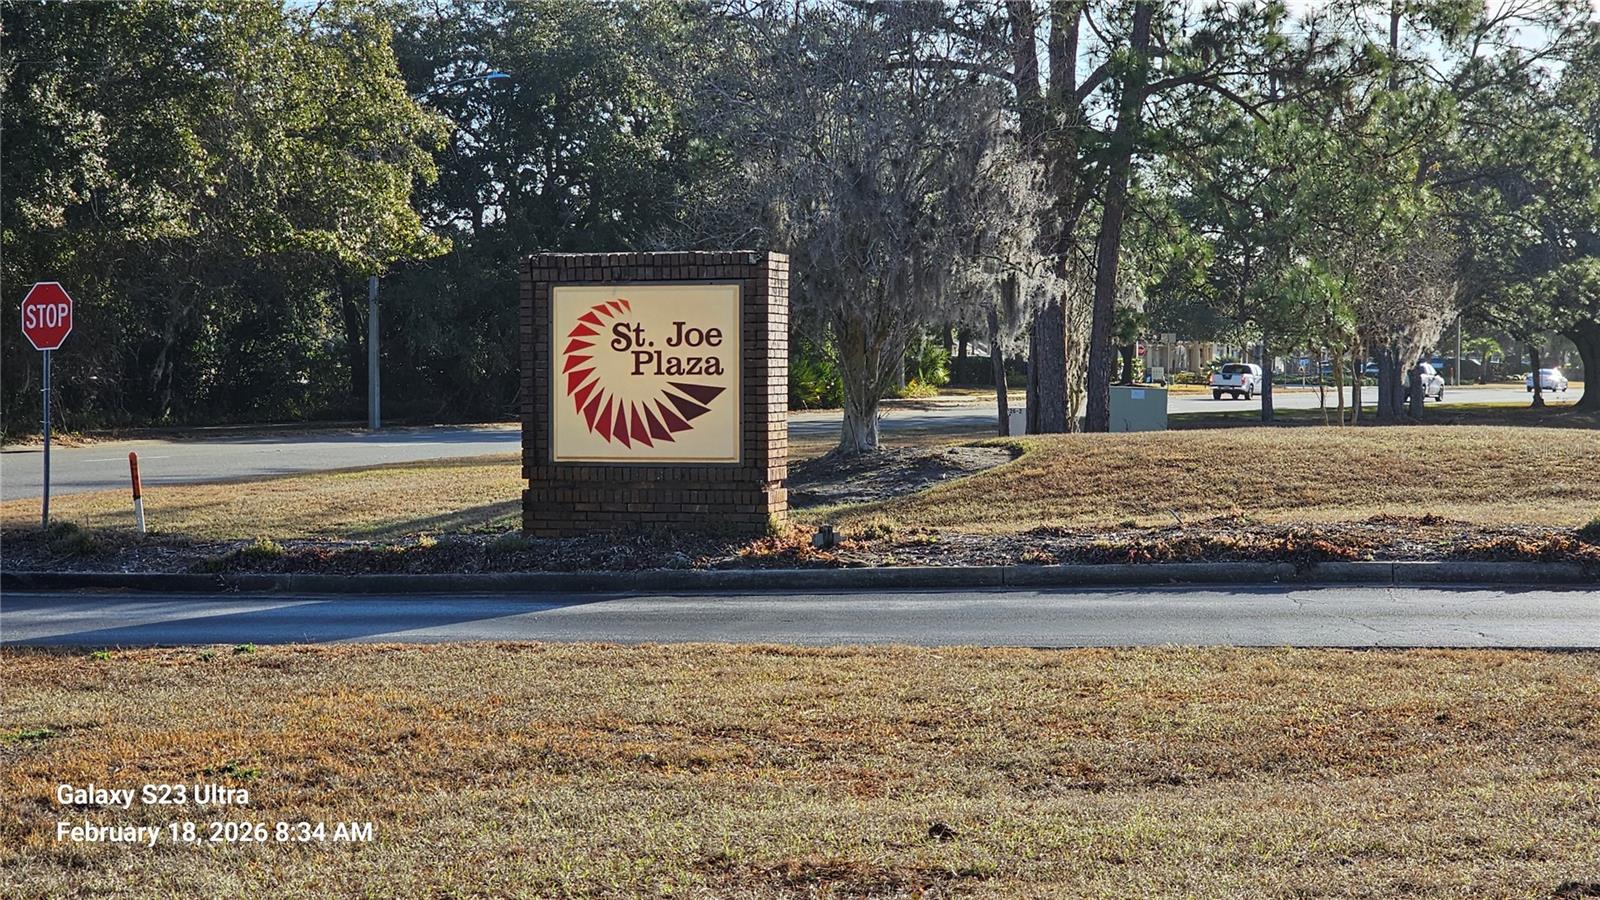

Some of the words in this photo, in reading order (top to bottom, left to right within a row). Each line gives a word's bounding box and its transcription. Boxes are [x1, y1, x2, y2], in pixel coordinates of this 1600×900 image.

[26, 304, 69, 329] STOP
[611, 322, 654, 352] St.
[666, 321, 723, 347] Joe
[631, 350, 724, 376] Plaza
